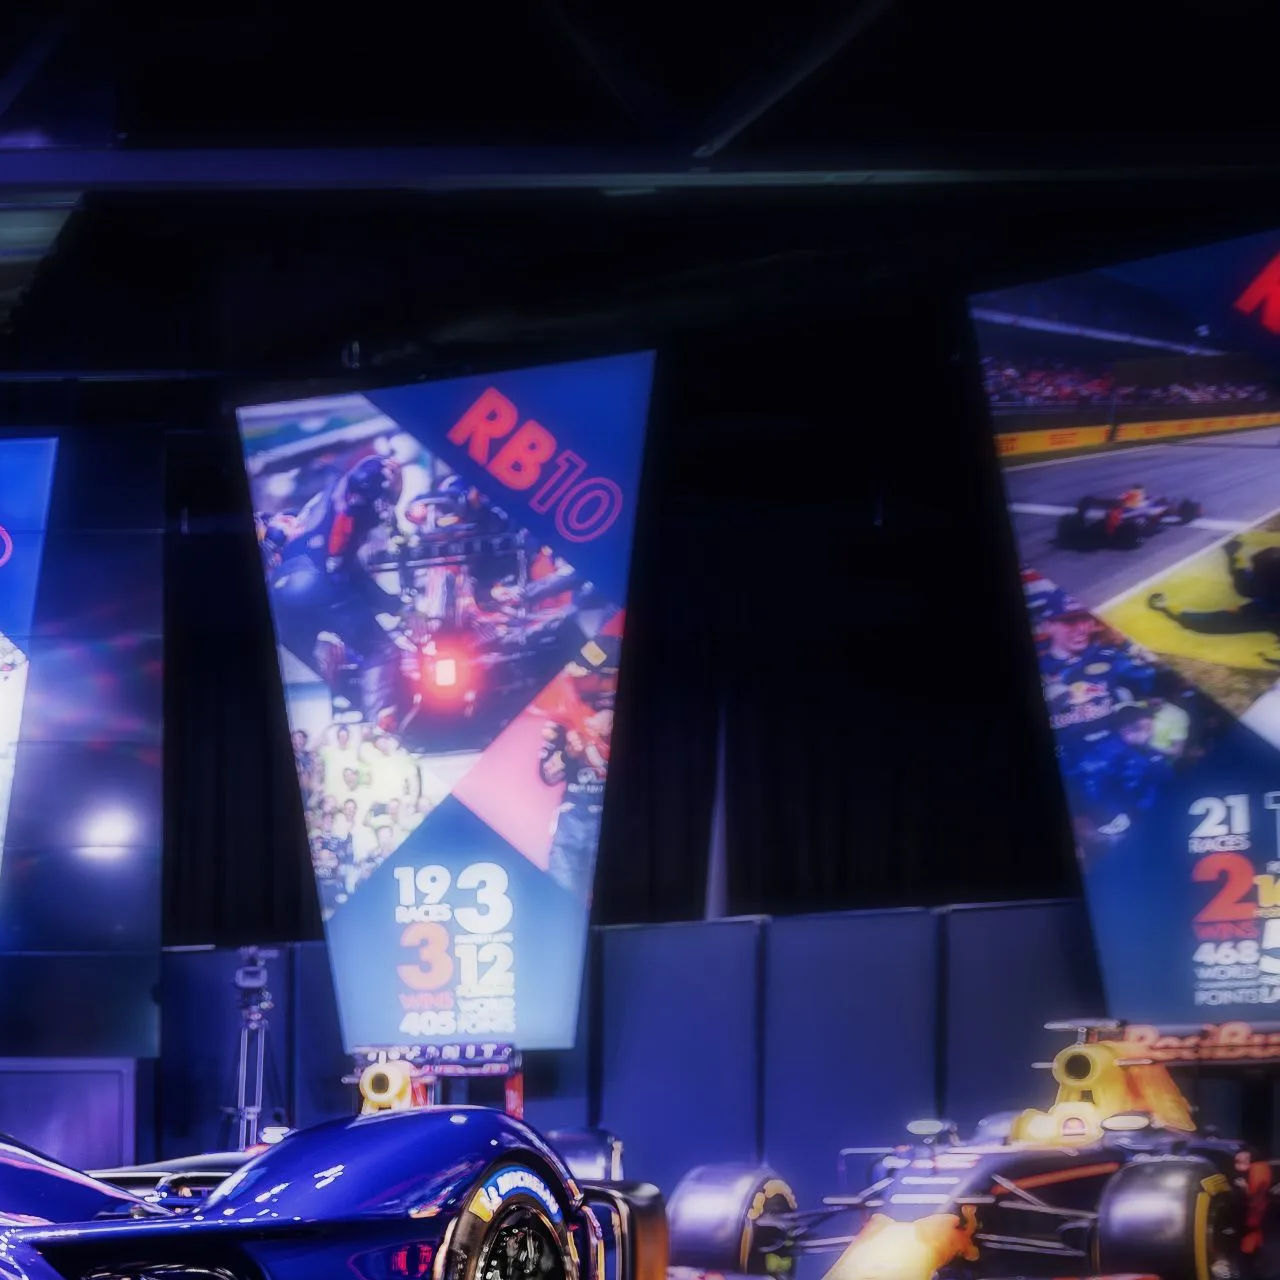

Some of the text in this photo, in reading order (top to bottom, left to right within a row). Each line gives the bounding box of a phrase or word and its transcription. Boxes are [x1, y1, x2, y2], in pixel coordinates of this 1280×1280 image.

[447, 387, 622, 542] RB10
[1188, 794, 1251, 838] 21
[393, 864, 451, 905] 19
[454, 862, 513, 934] 3
[1192, 852, 1257, 923] 2
[397, 921, 454, 990] 3
[455, 942, 515, 988] 12
